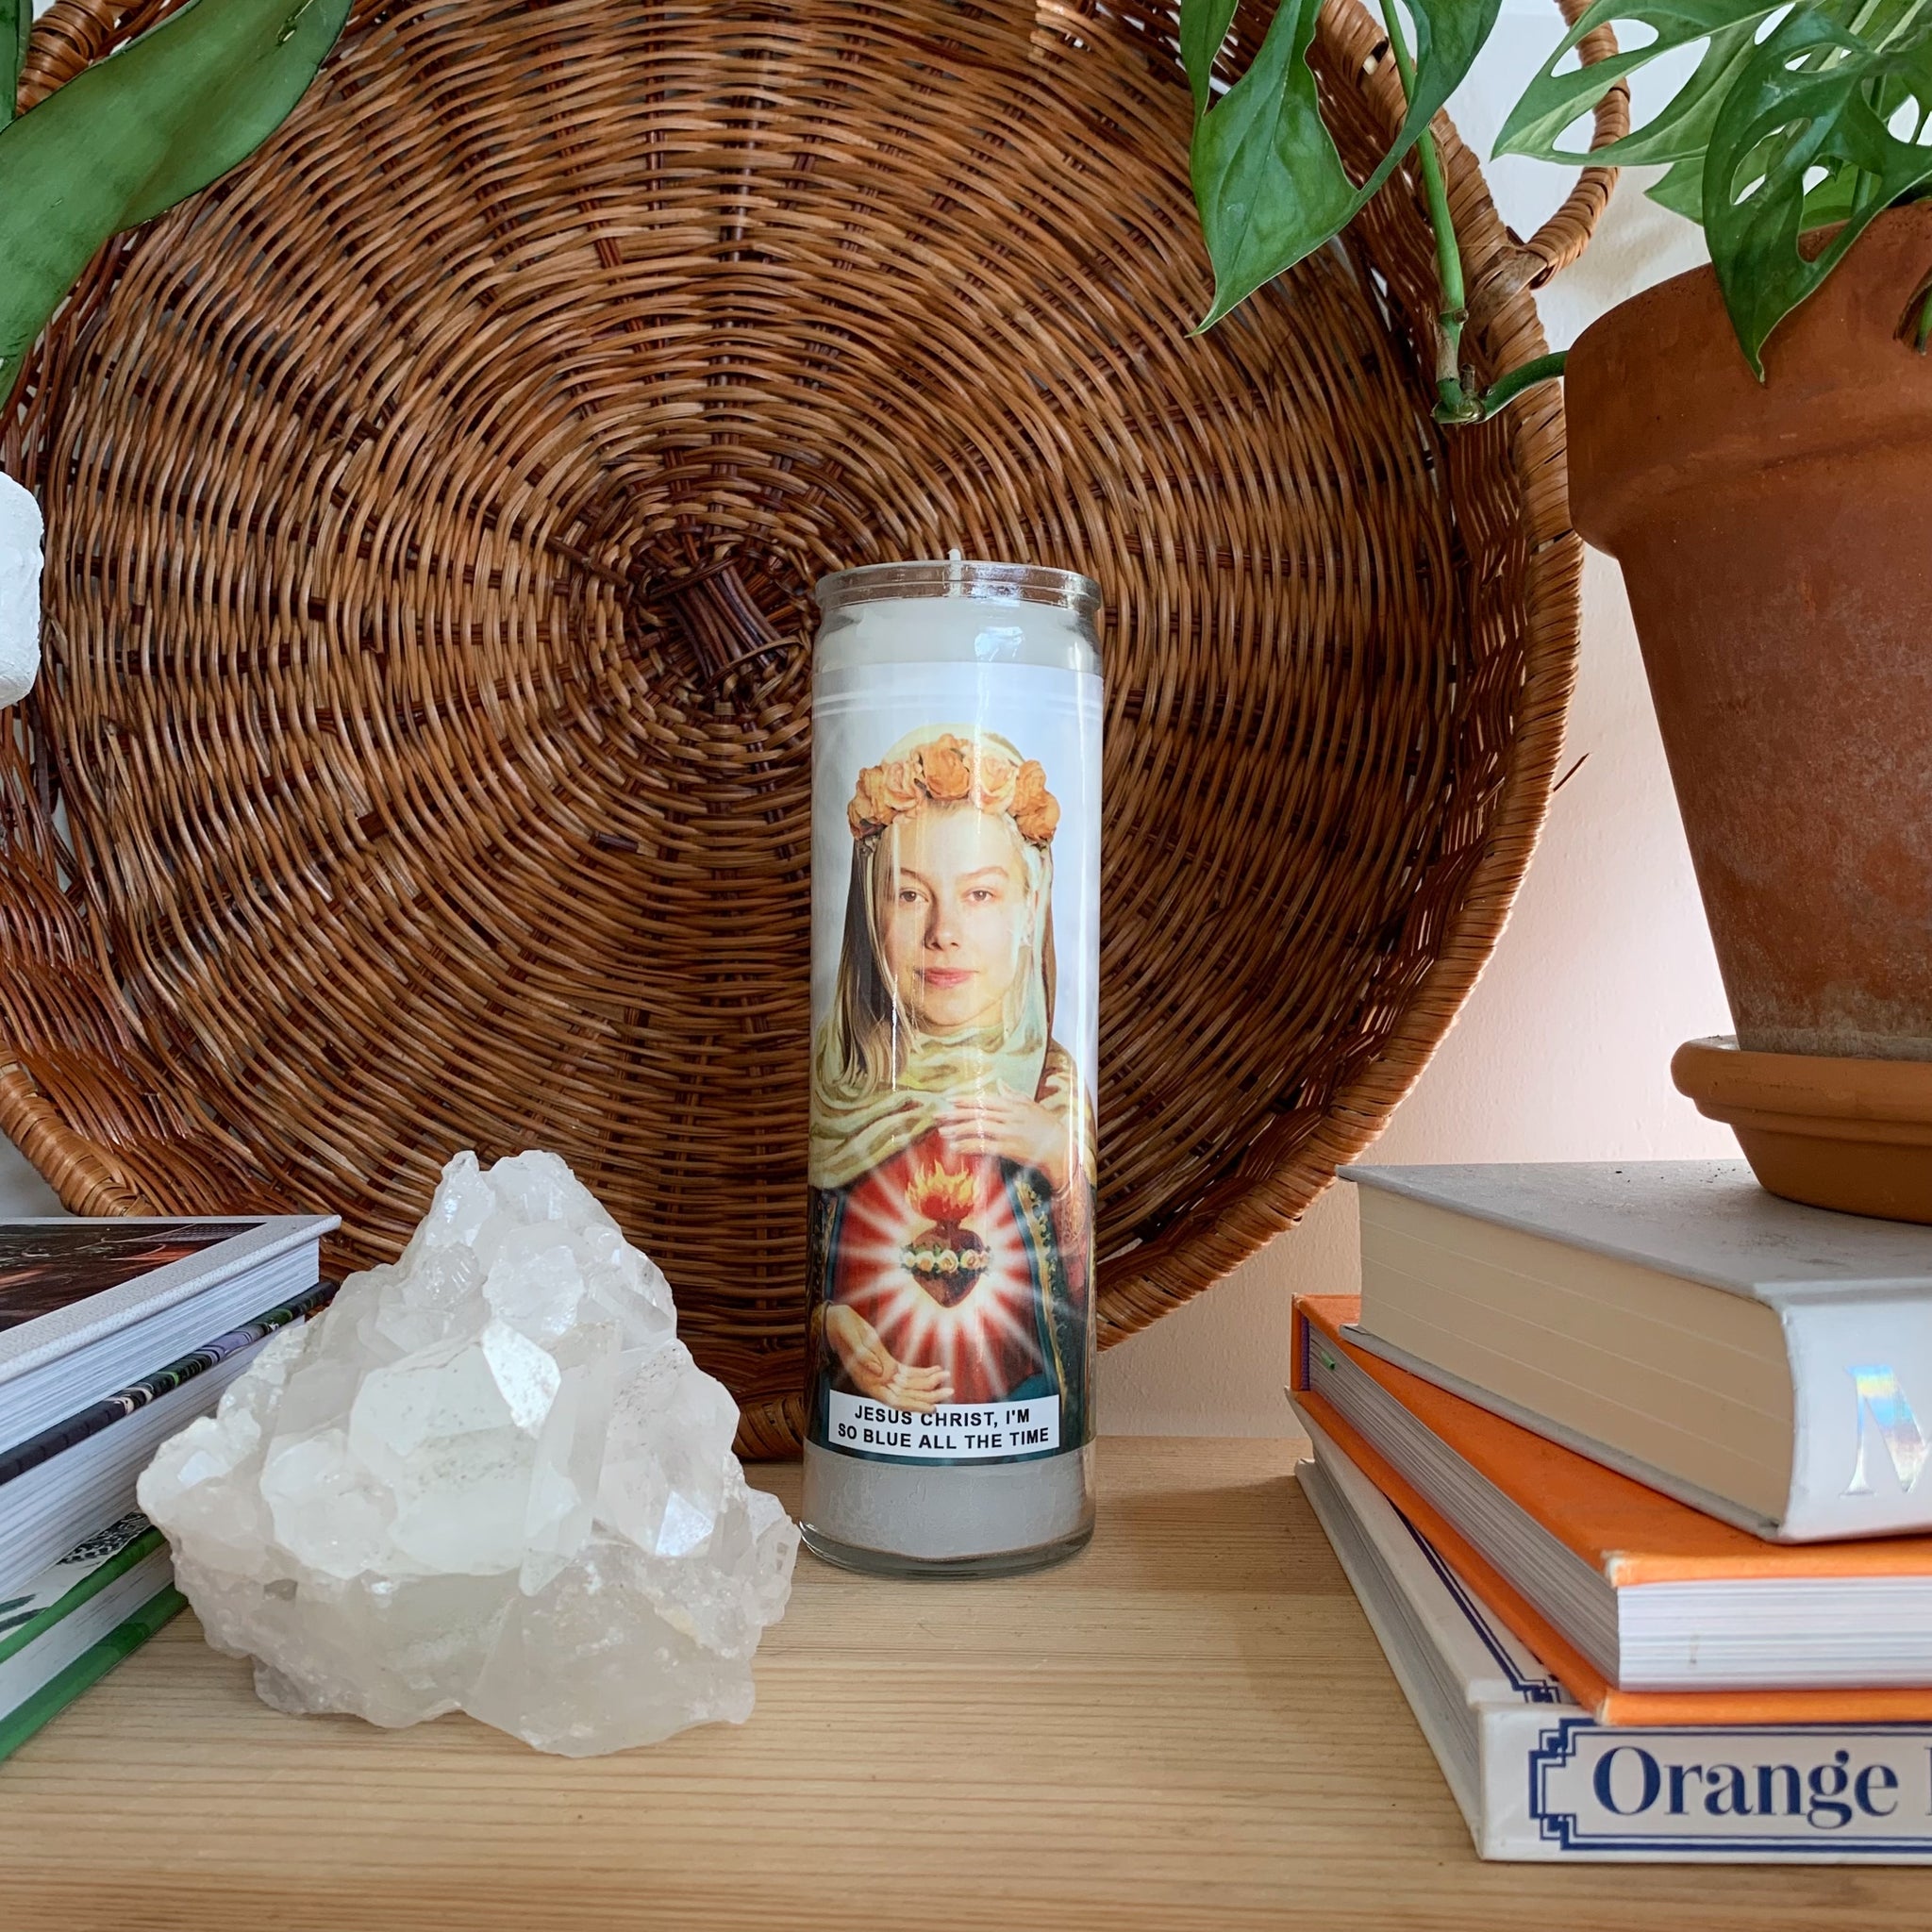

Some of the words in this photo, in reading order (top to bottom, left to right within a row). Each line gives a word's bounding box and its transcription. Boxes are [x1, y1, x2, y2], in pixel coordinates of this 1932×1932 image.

[855, 1405, 912, 1425] JESUS
[921, 1411, 998, 1428] CHRIST,
[1006, 1408, 1030, 1424] I'M
[838, 1423, 858, 1440] SO
[863, 1428, 911, 1447] BLUE
[919, 1434, 957, 1449] ALL
[965, 1433, 1002, 1449] THE
[1009, 1427, 1049, 1446] TIME
[1592, 1746, 1899, 1829] Orange
